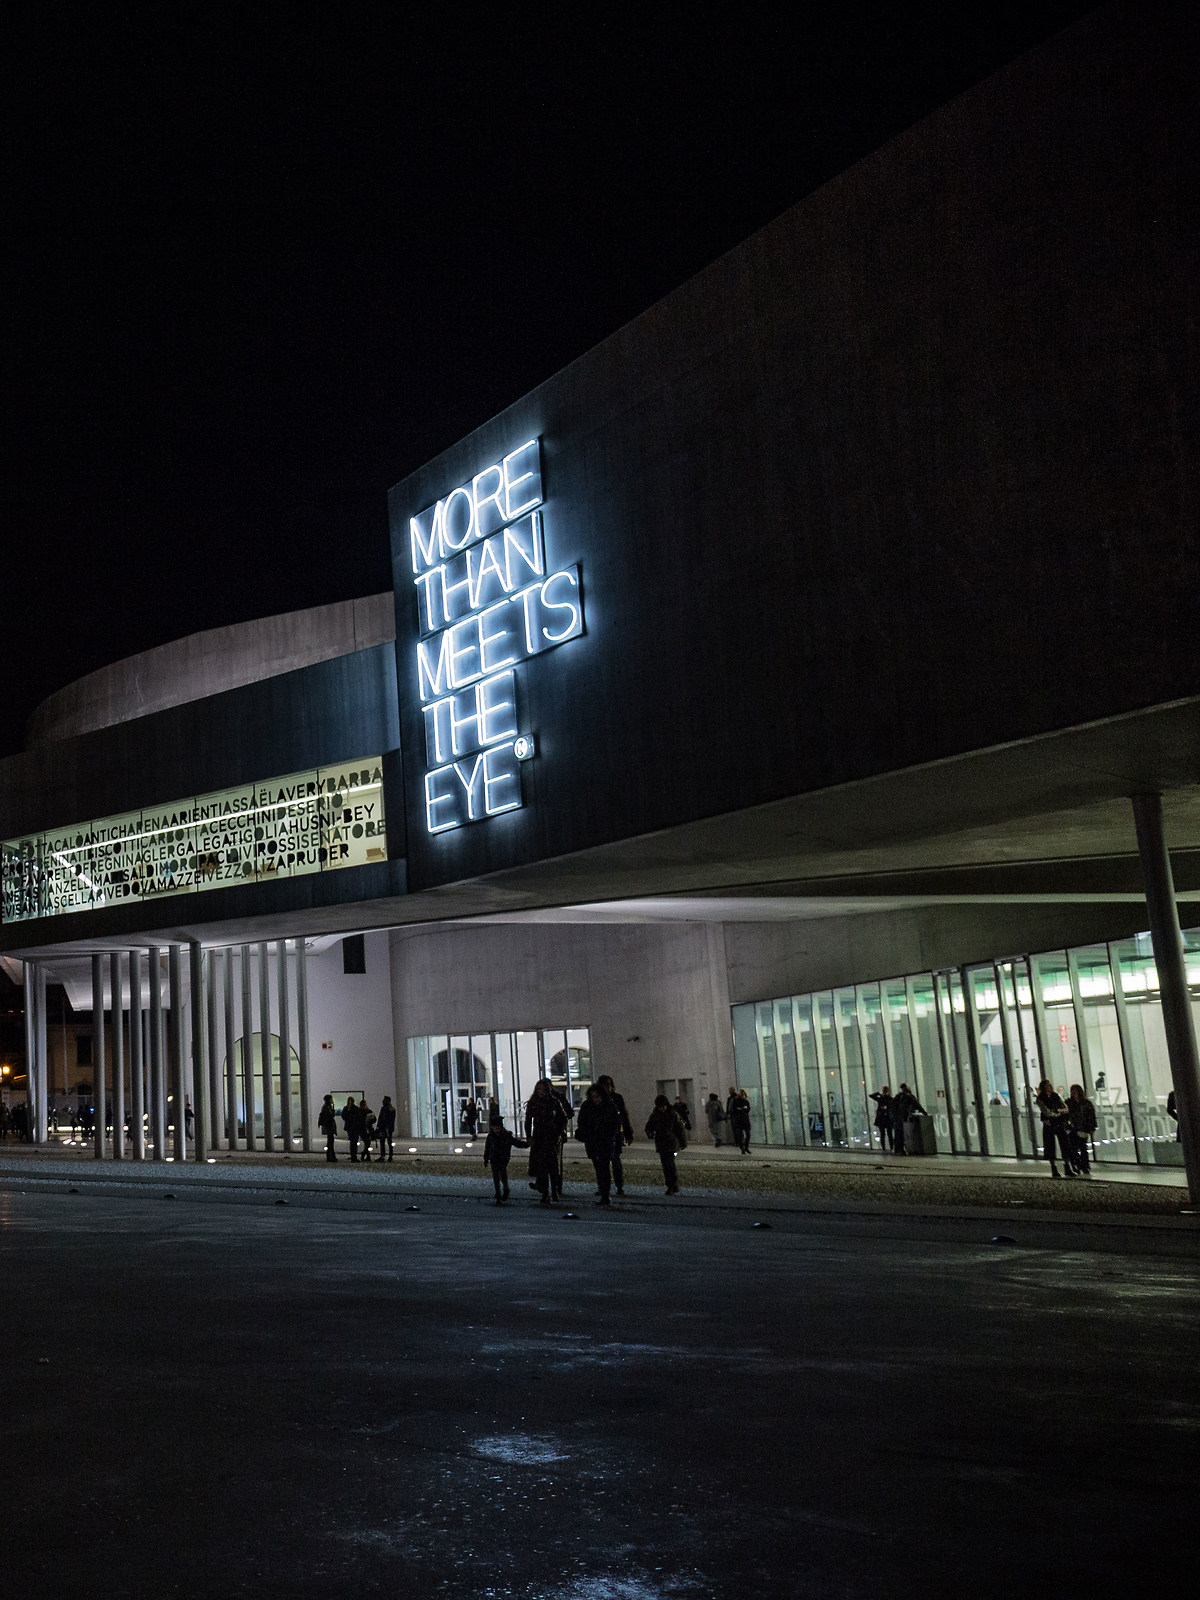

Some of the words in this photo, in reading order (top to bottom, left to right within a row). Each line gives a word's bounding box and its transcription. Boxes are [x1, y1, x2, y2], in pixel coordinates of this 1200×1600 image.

[409, 438, 542, 575] MORE
[413, 511, 542, 632] THAN
[416, 570, 578, 701] MEETS
[421, 670, 516, 763] THE
[424, 741, 518, 834] EYE
